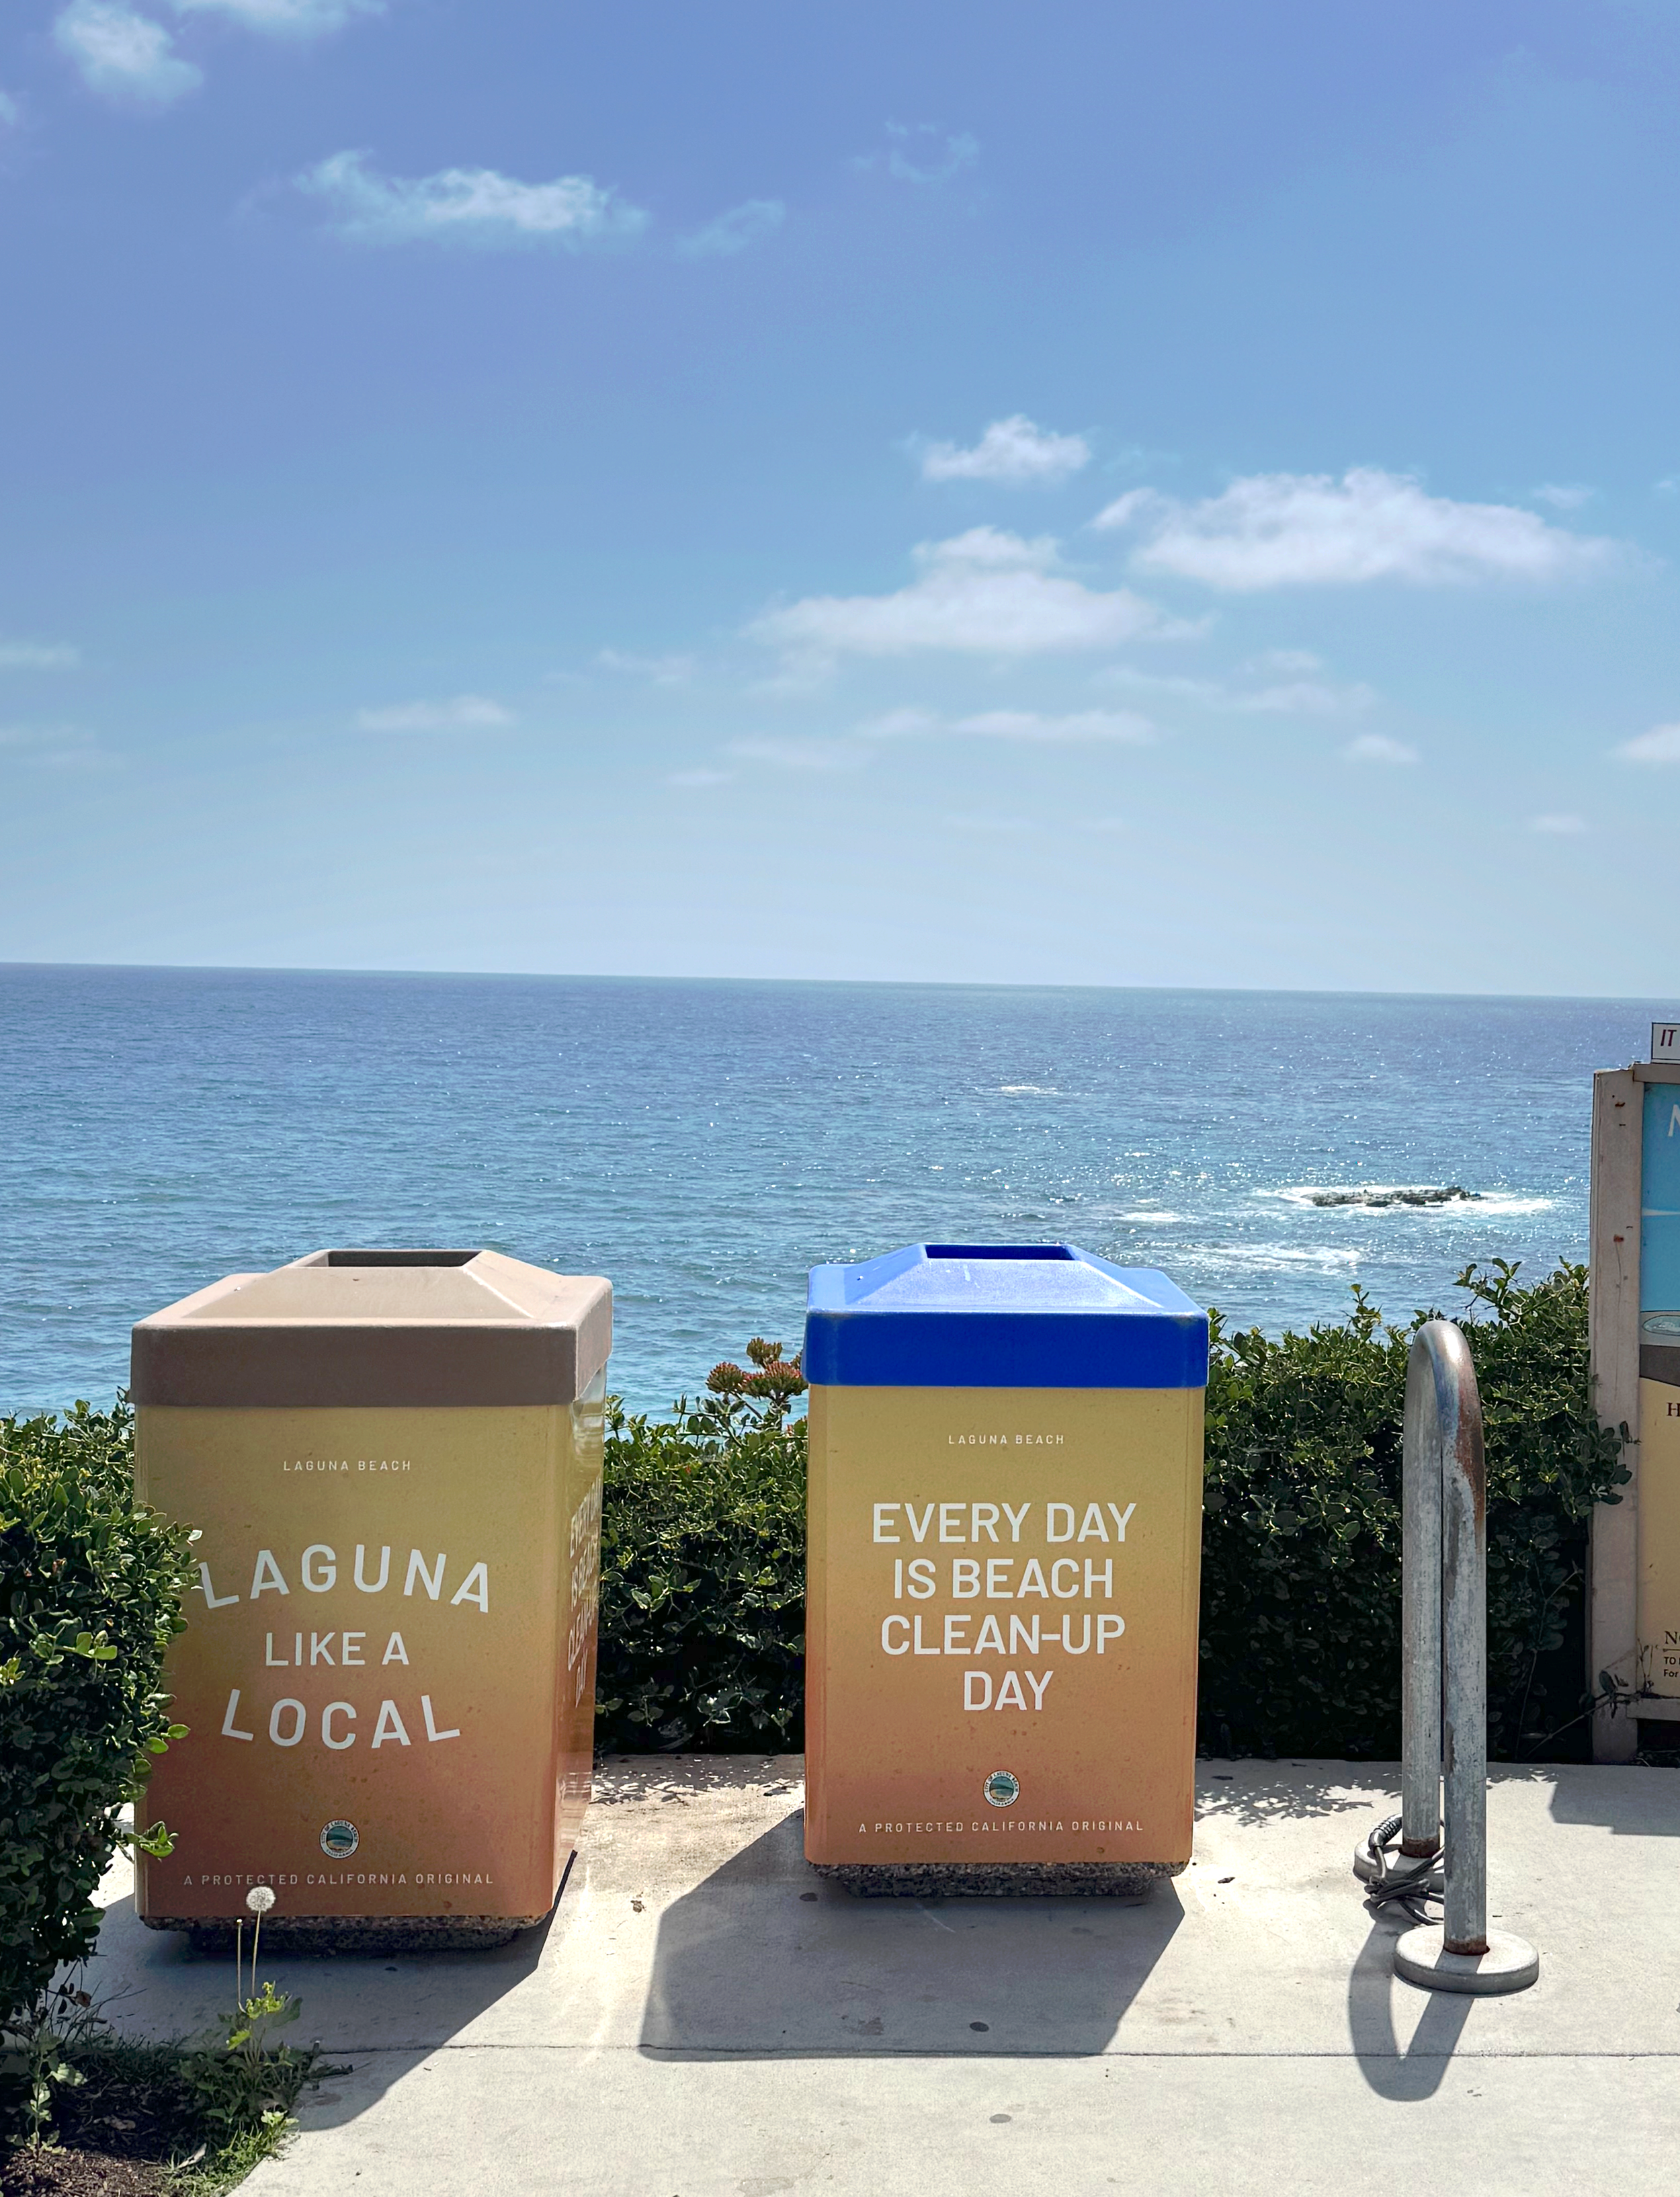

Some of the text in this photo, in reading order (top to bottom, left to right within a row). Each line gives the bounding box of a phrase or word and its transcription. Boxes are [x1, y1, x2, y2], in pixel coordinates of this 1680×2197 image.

[1661, 1029, 1677, 1046] IT
[948, 1434, 1064, 1444] LAGUNA BEACH
[284, 1460, 410, 1471] LAGUNA BEACH
[874, 1502, 1137, 1542] EVERY DAY
[199, 1544, 489, 1614] LAGUNA
[894, 1558, 1113, 1599] IS BEACH
[881, 1614, 1126, 1655] CLEAN-UP
[265, 1631, 410, 1666] LIKE A
[1664, 1657, 1676, 1665] TO
[1664, 1669, 1679, 1677] For
[964, 1670, 1054, 1711] DAY
[221, 1689, 460, 1750] LOCAL
[858, 1820, 1144, 1833] A PROTECTED CALIFORNIA ORIGINAL
[183, 1872, 493, 1886] A PROTECTED CALIFORNIA ORIGINAL
